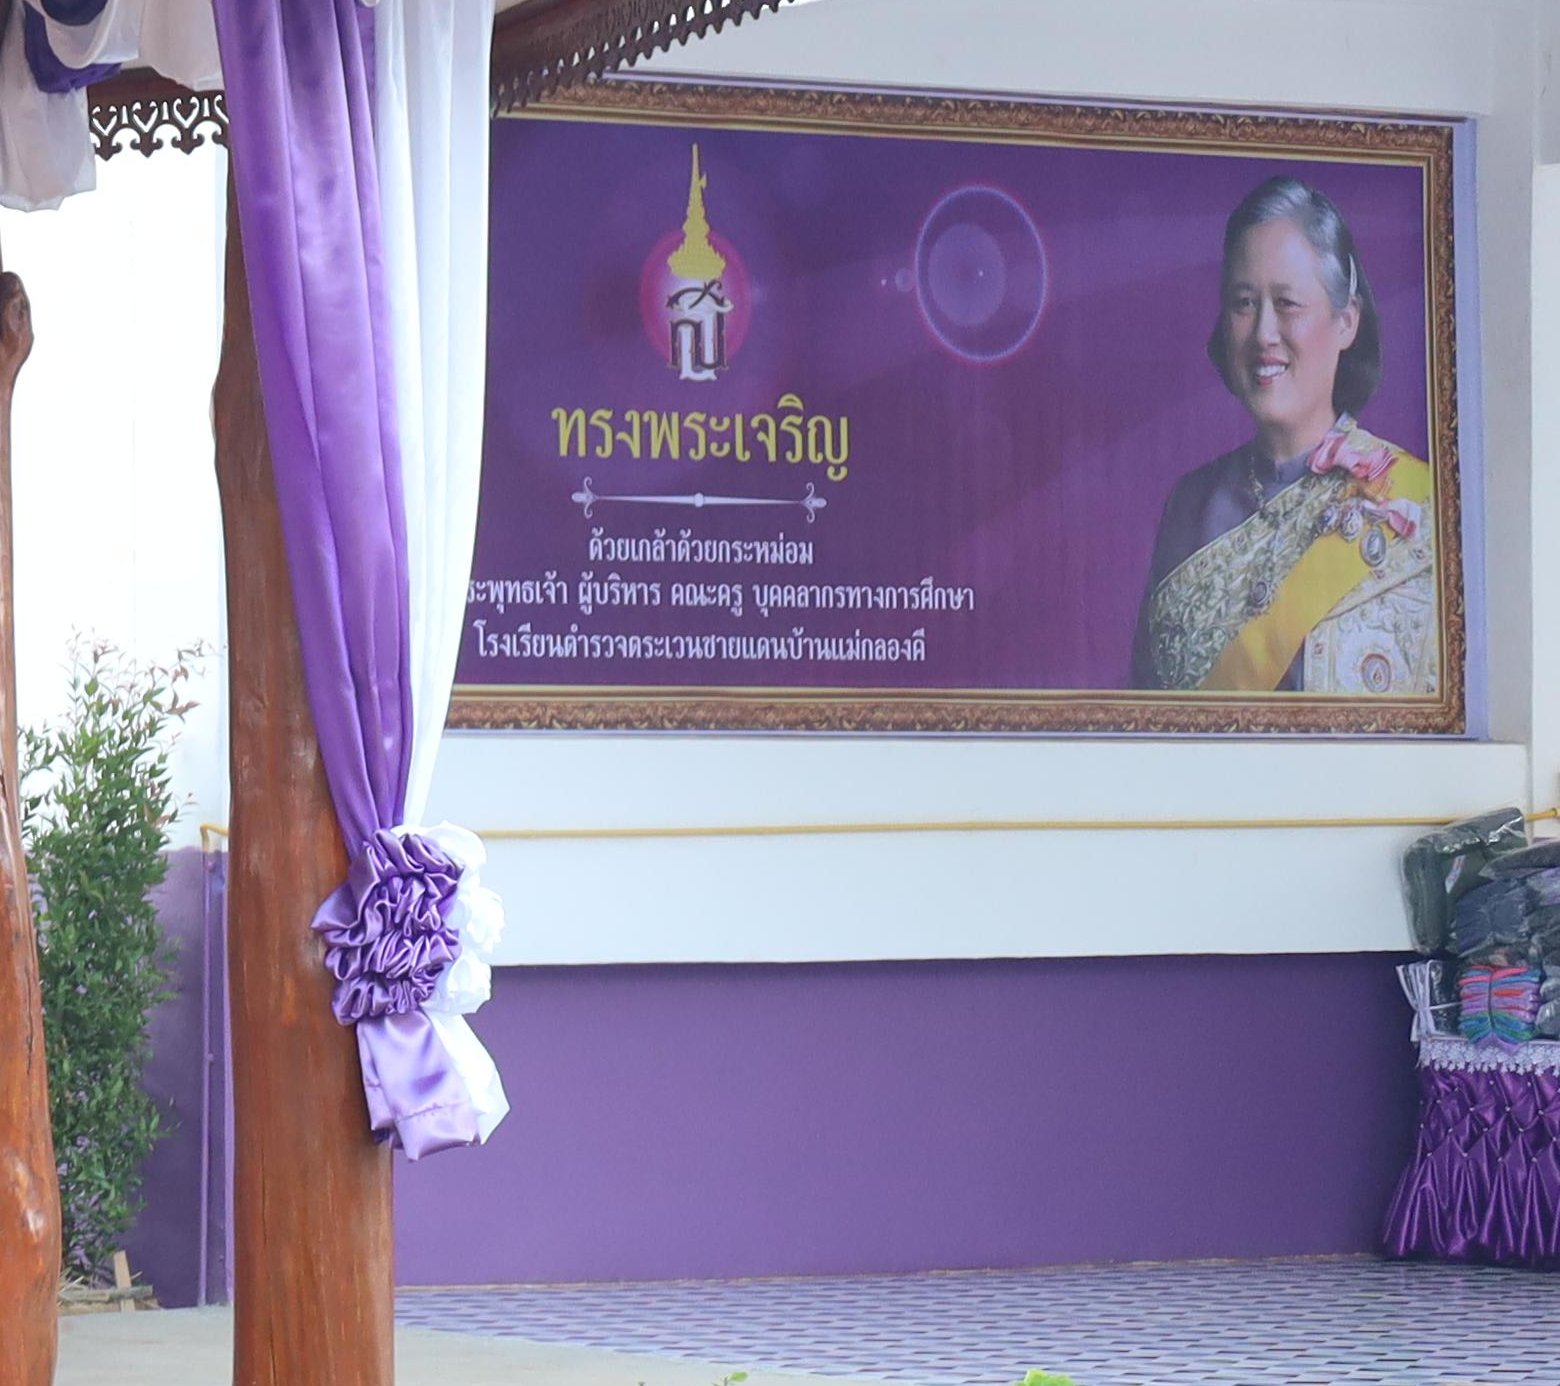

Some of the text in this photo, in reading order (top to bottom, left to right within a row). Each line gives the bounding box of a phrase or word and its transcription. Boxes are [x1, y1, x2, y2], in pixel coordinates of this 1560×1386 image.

[551, 393, 849, 481] ทรงพระเจริญ
[589, 527, 814, 564] ด้วยเกล้าด้วยกระหม่อม
[578, 570, 662, 615] ผู้บริหาร
[671, 583, 743, 617] คณะครู
[752, 576, 975, 617] บุคคลากรทางการศึกษา
[473, 619, 926, 662] โรงเรียนตำรวจตระเวนชายแดนบ้านแม่กลองคี
